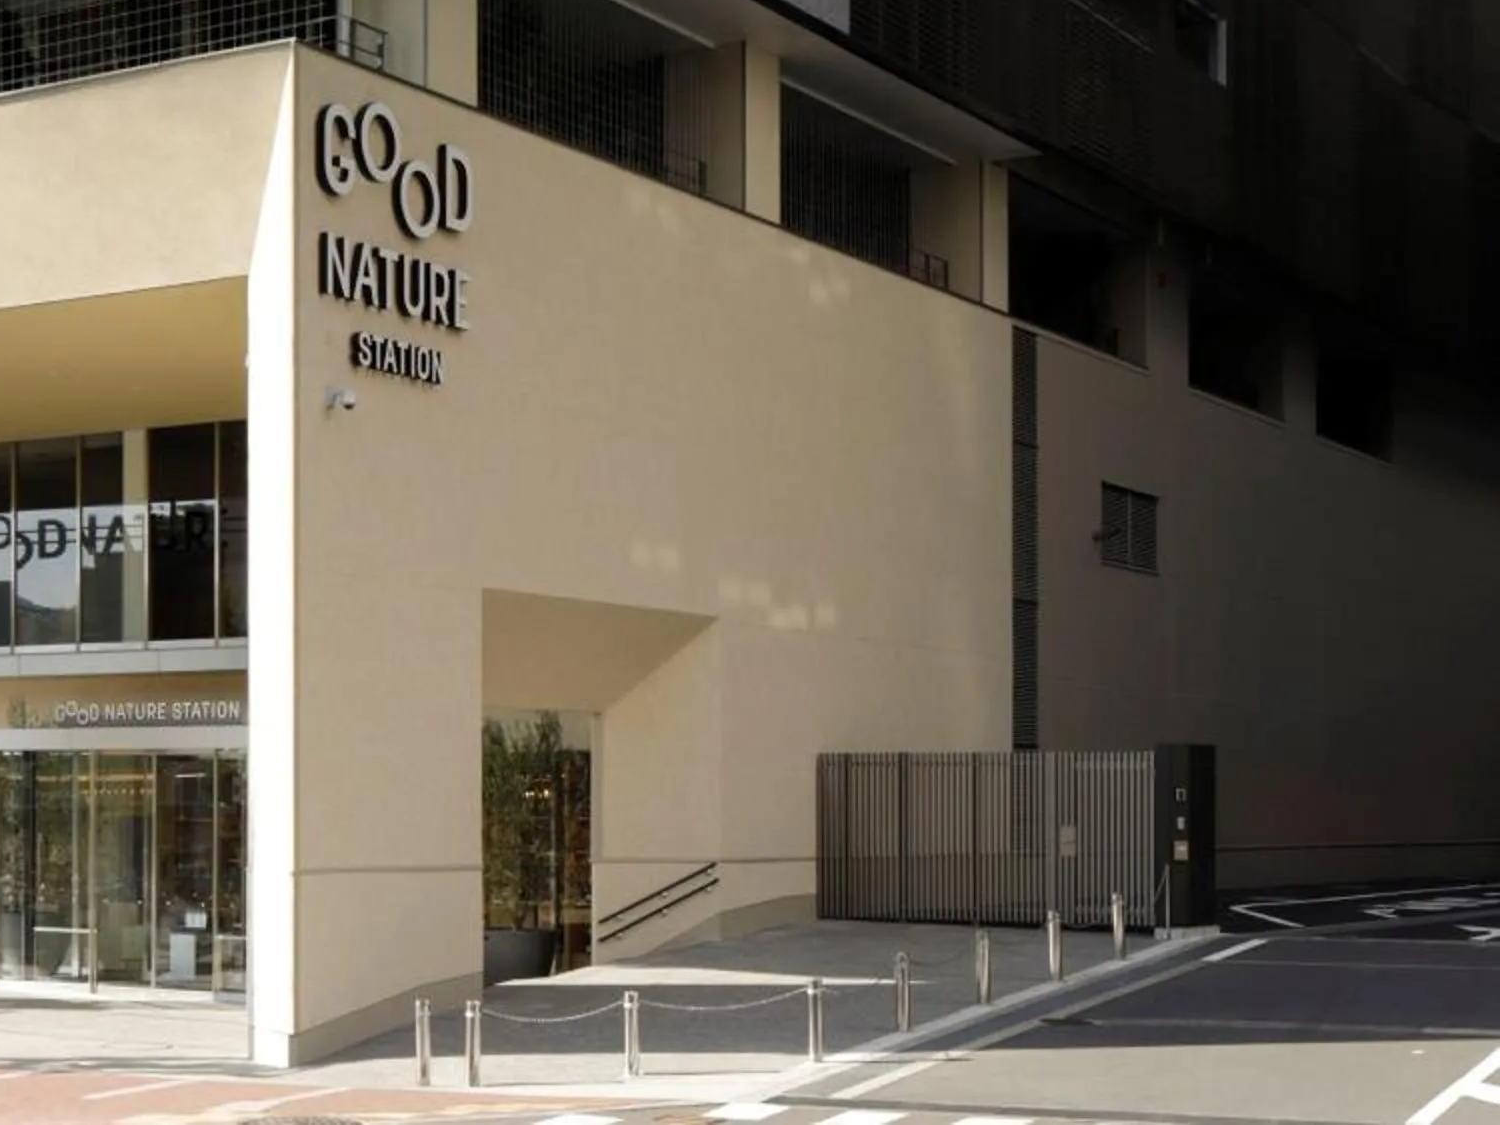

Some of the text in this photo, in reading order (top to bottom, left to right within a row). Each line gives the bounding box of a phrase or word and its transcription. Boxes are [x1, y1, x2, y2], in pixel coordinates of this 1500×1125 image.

[318, 101, 474, 239] GOOD
[320, 231, 472, 331] NATURE
[355, 330, 444, 384] STATION
[55, 699, 242, 725] GOOD NATURE STATION
